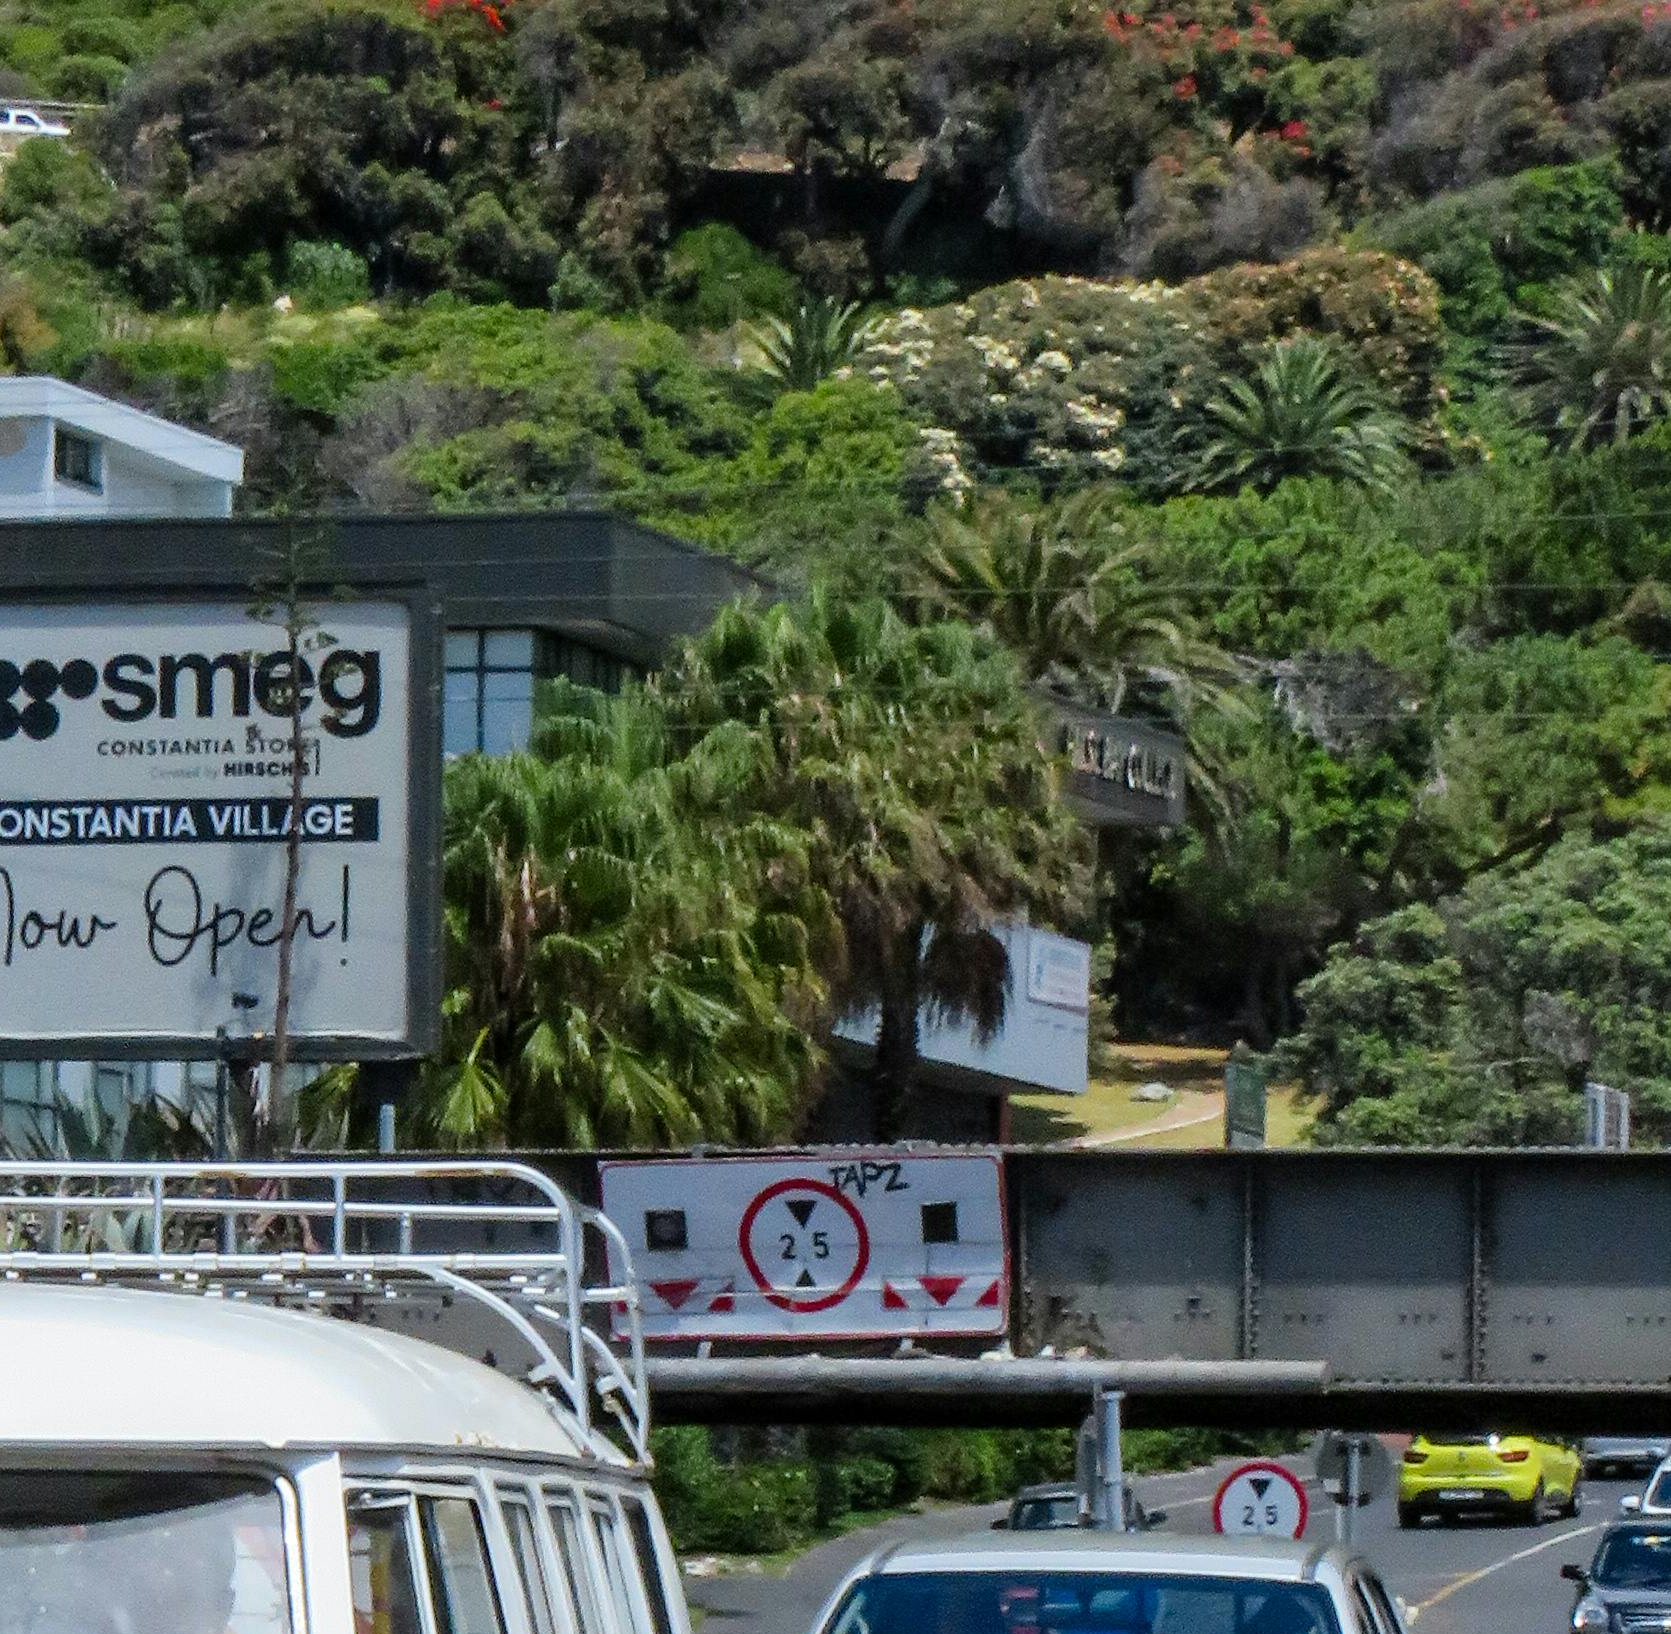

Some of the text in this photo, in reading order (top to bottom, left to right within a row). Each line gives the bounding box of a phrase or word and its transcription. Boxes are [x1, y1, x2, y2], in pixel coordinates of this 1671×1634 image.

[101, 649, 381, 738] smeg
[96, 738, 235, 757] CONSTANTIA
[209, 803, 355, 837] VILLAGE
[144, 863, 350, 978] Open!
